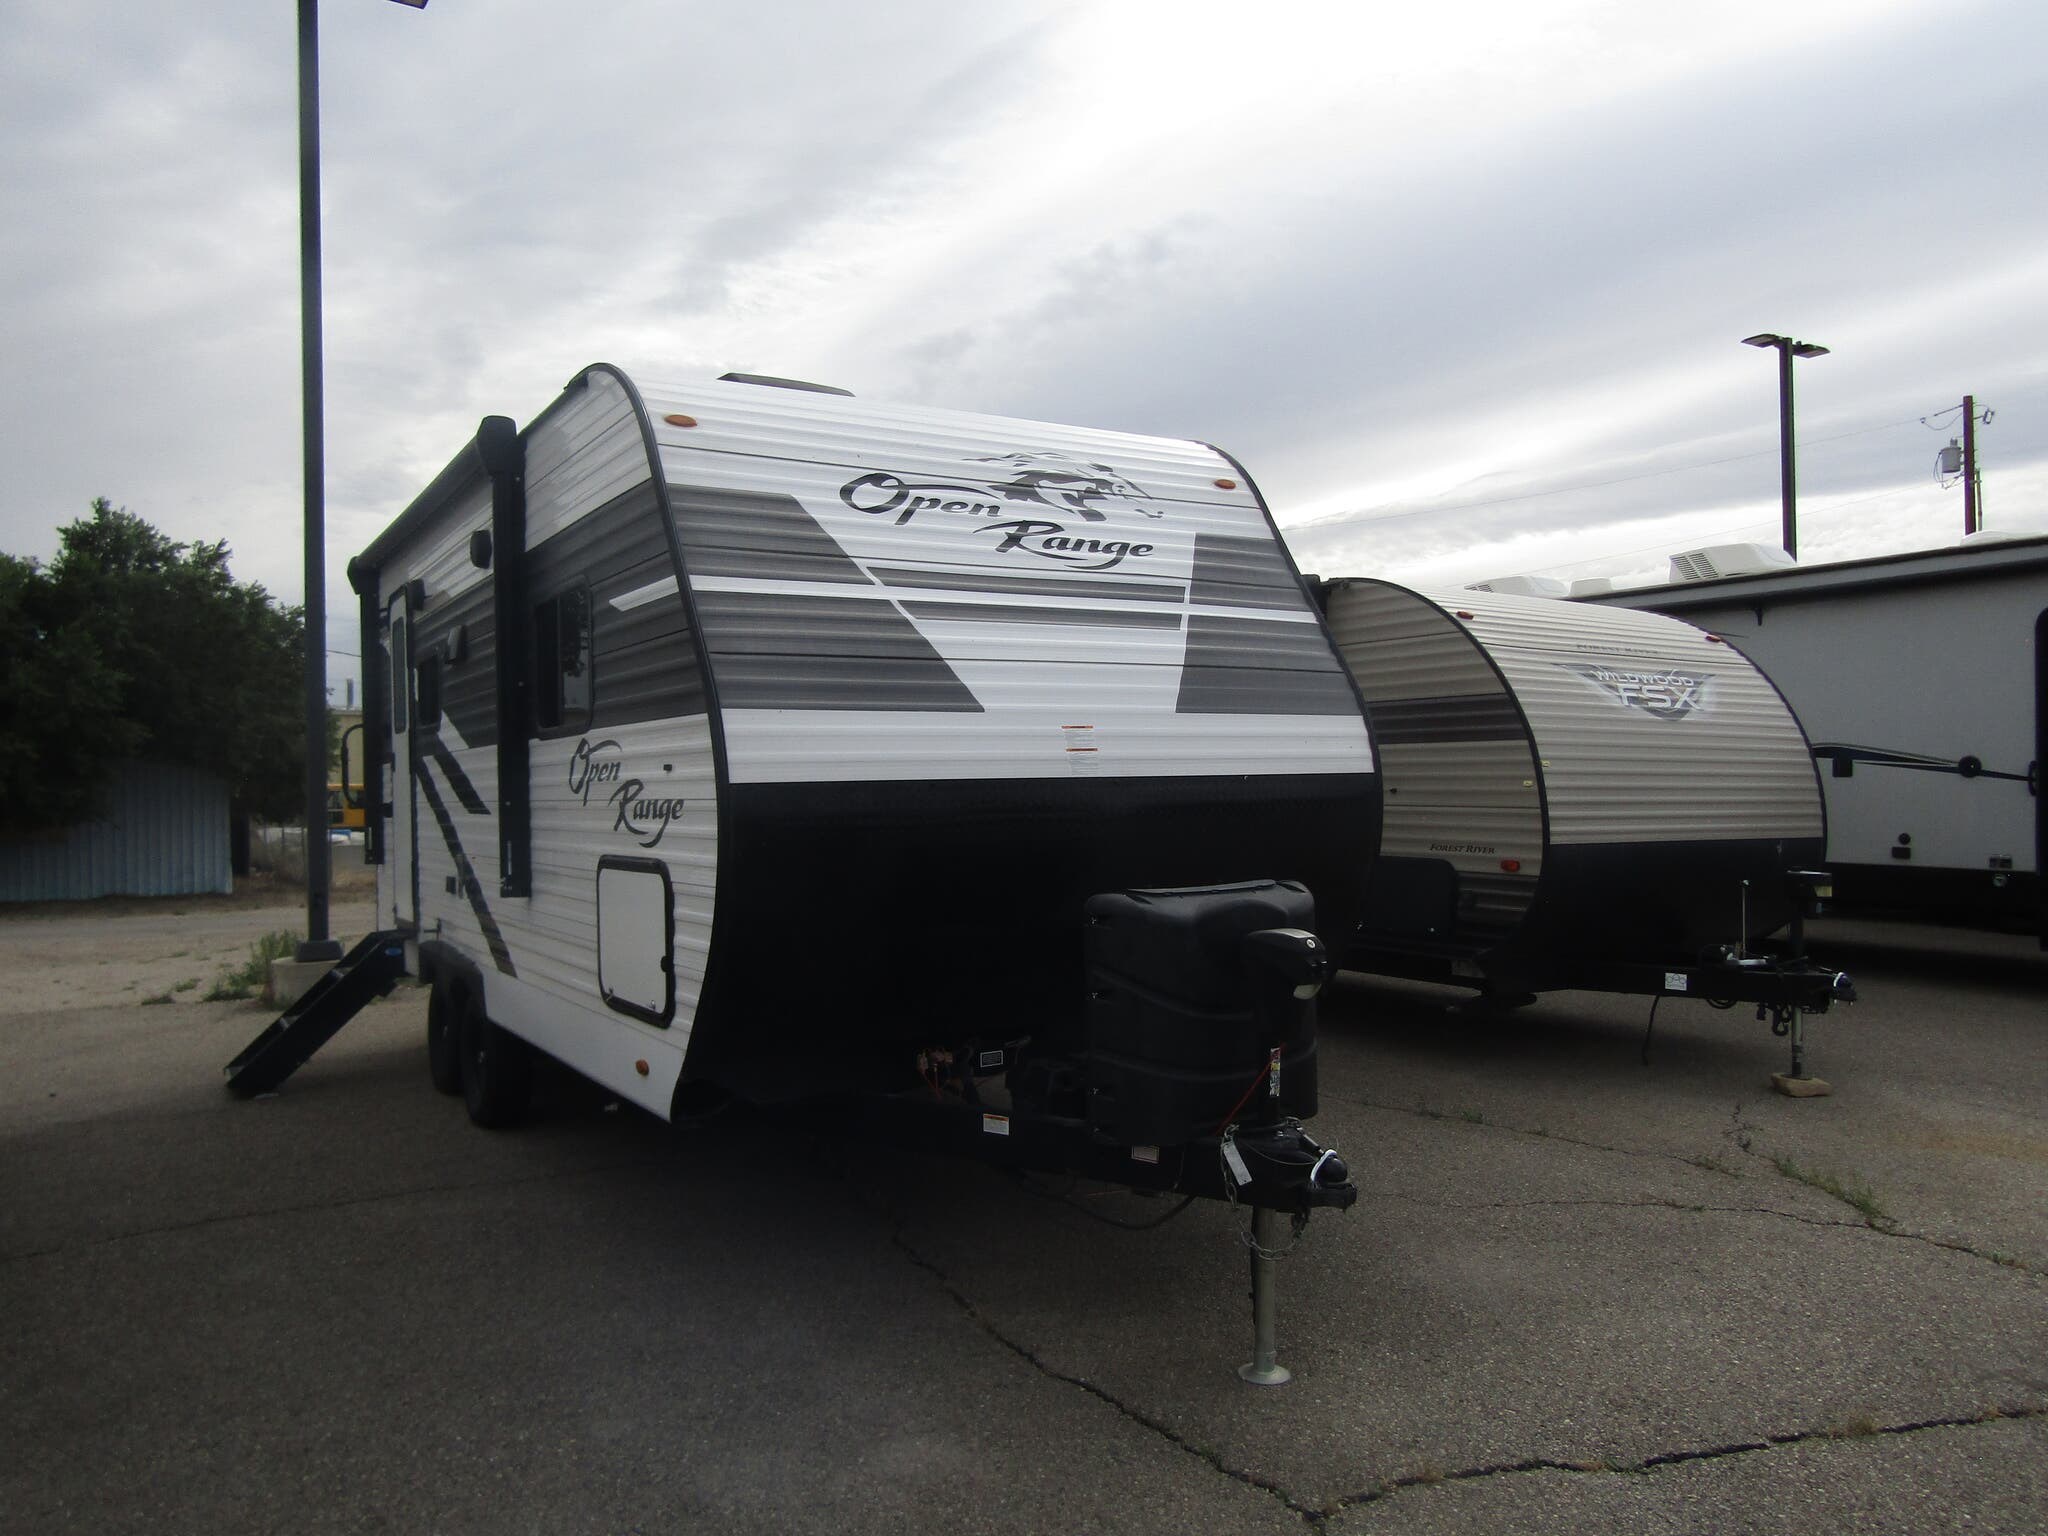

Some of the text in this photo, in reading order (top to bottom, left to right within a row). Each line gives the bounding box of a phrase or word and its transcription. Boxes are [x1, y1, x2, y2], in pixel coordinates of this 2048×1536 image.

[839, 472, 1001, 526] Open
[973, 520, 1154, 570] Range
[1593, 670, 1696, 686] WILDWOOD
[1615, 682, 1703, 711] FSX
[569, 738, 622, 807] Open
[608, 779, 684, 848] Range
[1429, 842, 1496, 855] FOREST RIVER
